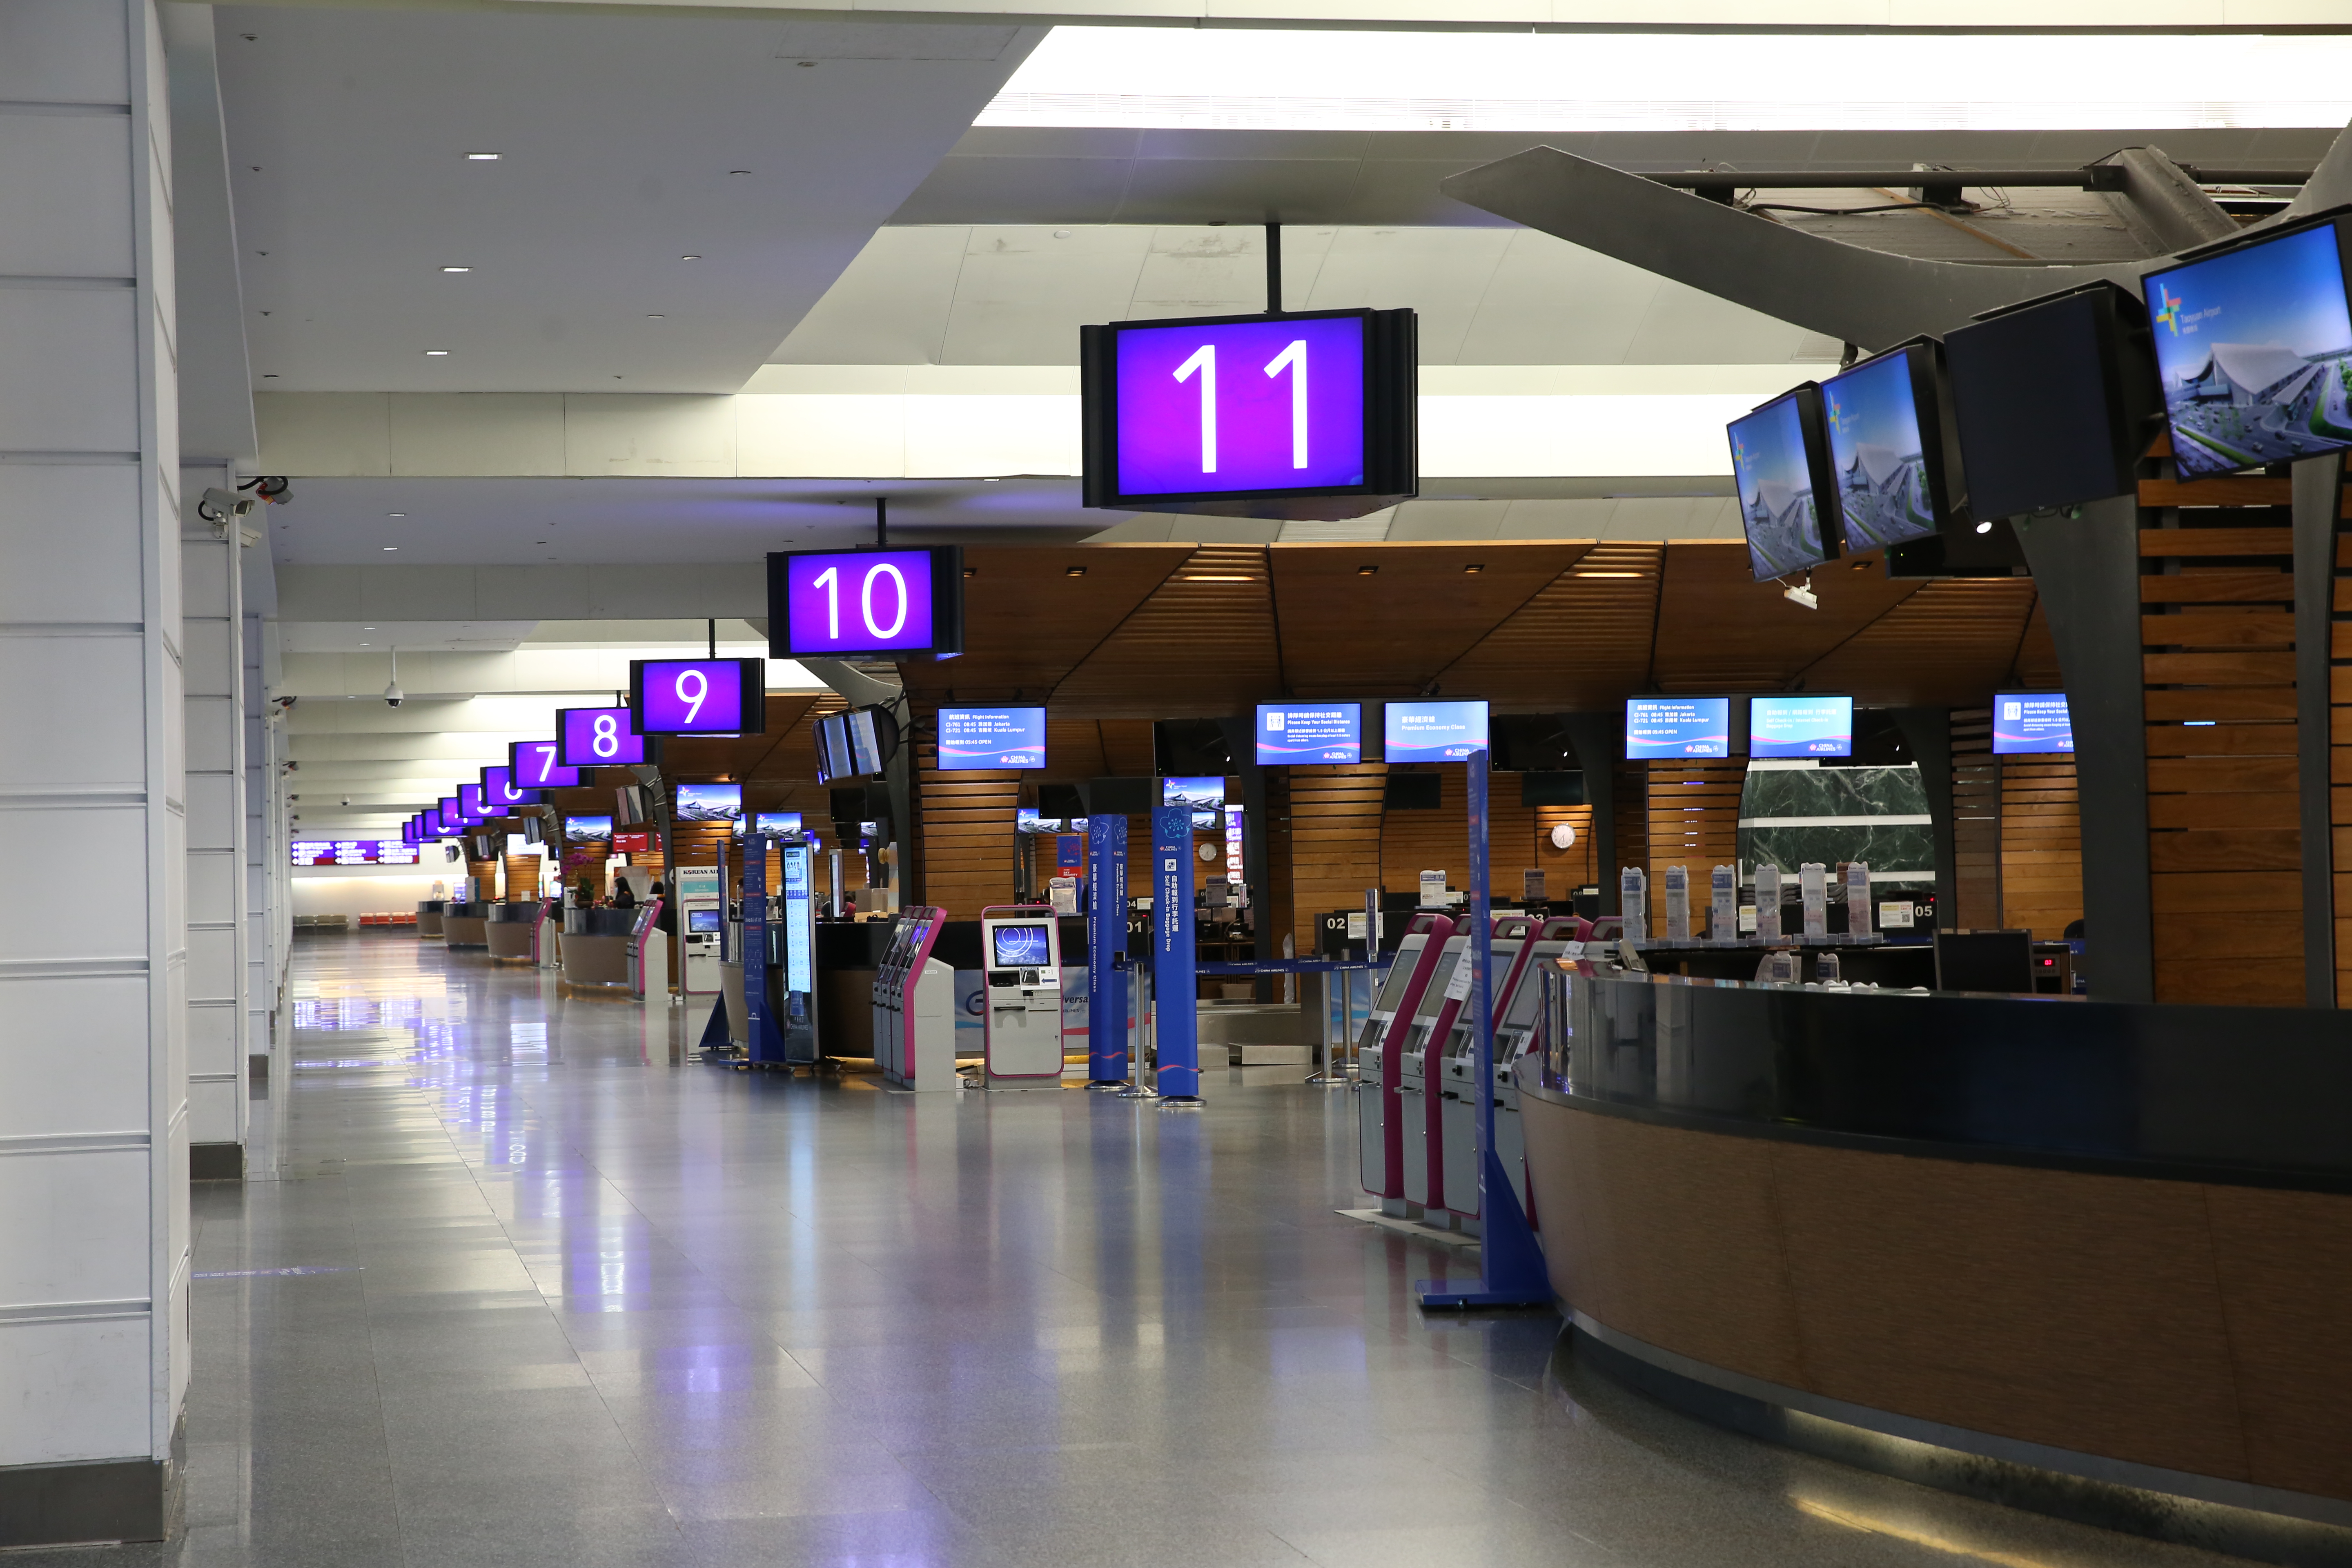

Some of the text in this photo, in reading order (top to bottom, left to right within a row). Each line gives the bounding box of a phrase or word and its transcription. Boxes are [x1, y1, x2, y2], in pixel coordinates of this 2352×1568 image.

[2203, 306, 2221, 321] Airport
[1173, 340, 1307, 473] 11
[813, 564, 907, 639] 10
[676, 670, 708, 723] 9
[1402, 715, 1435, 724] 豪華經濟艙
[592, 715, 619, 757] 8
[536, 746, 556, 782] 7
[1327, 918, 1345, 929] 02
[1915, 905, 1933, 917] 05
[1127, 921, 1141, 933] 01
